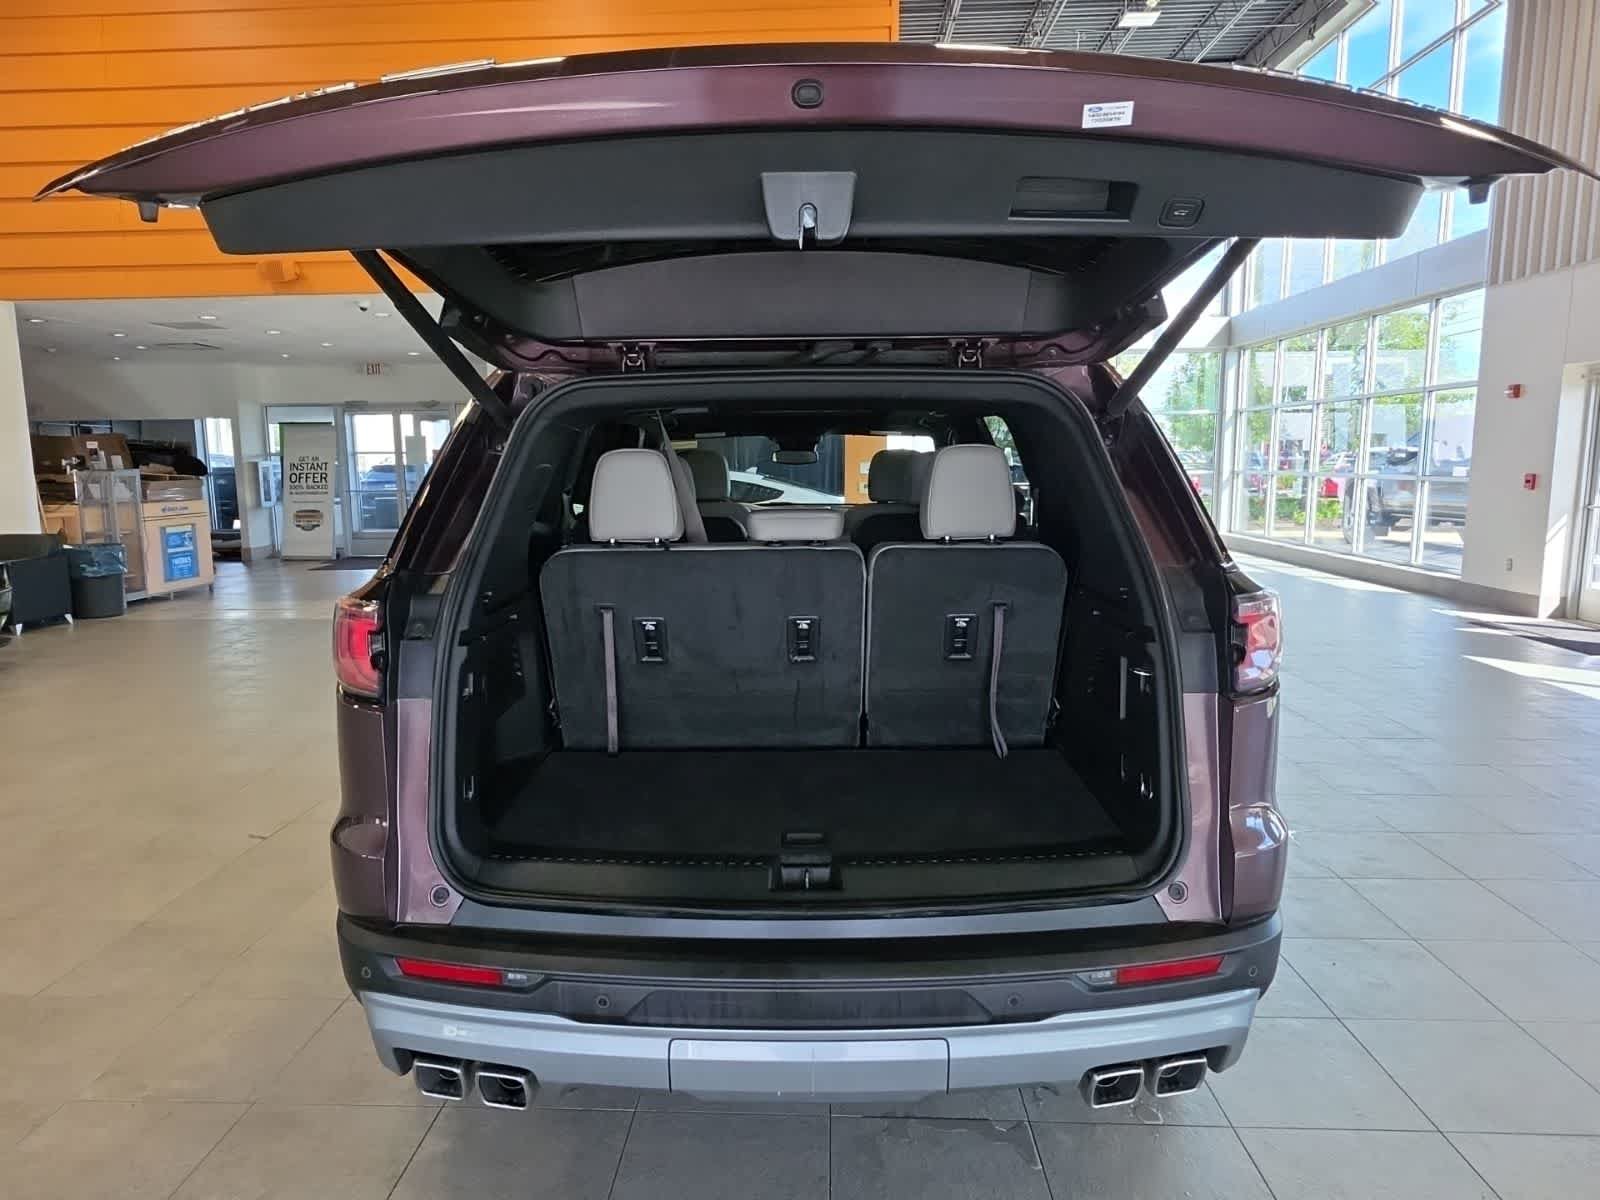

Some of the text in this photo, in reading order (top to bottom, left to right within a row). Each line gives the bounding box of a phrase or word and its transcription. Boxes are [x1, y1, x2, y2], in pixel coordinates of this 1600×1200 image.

[366, 362, 383, 376] EXIT
[289, 462, 328, 471] INSTANT
[289, 472, 328, 483] OFFER
